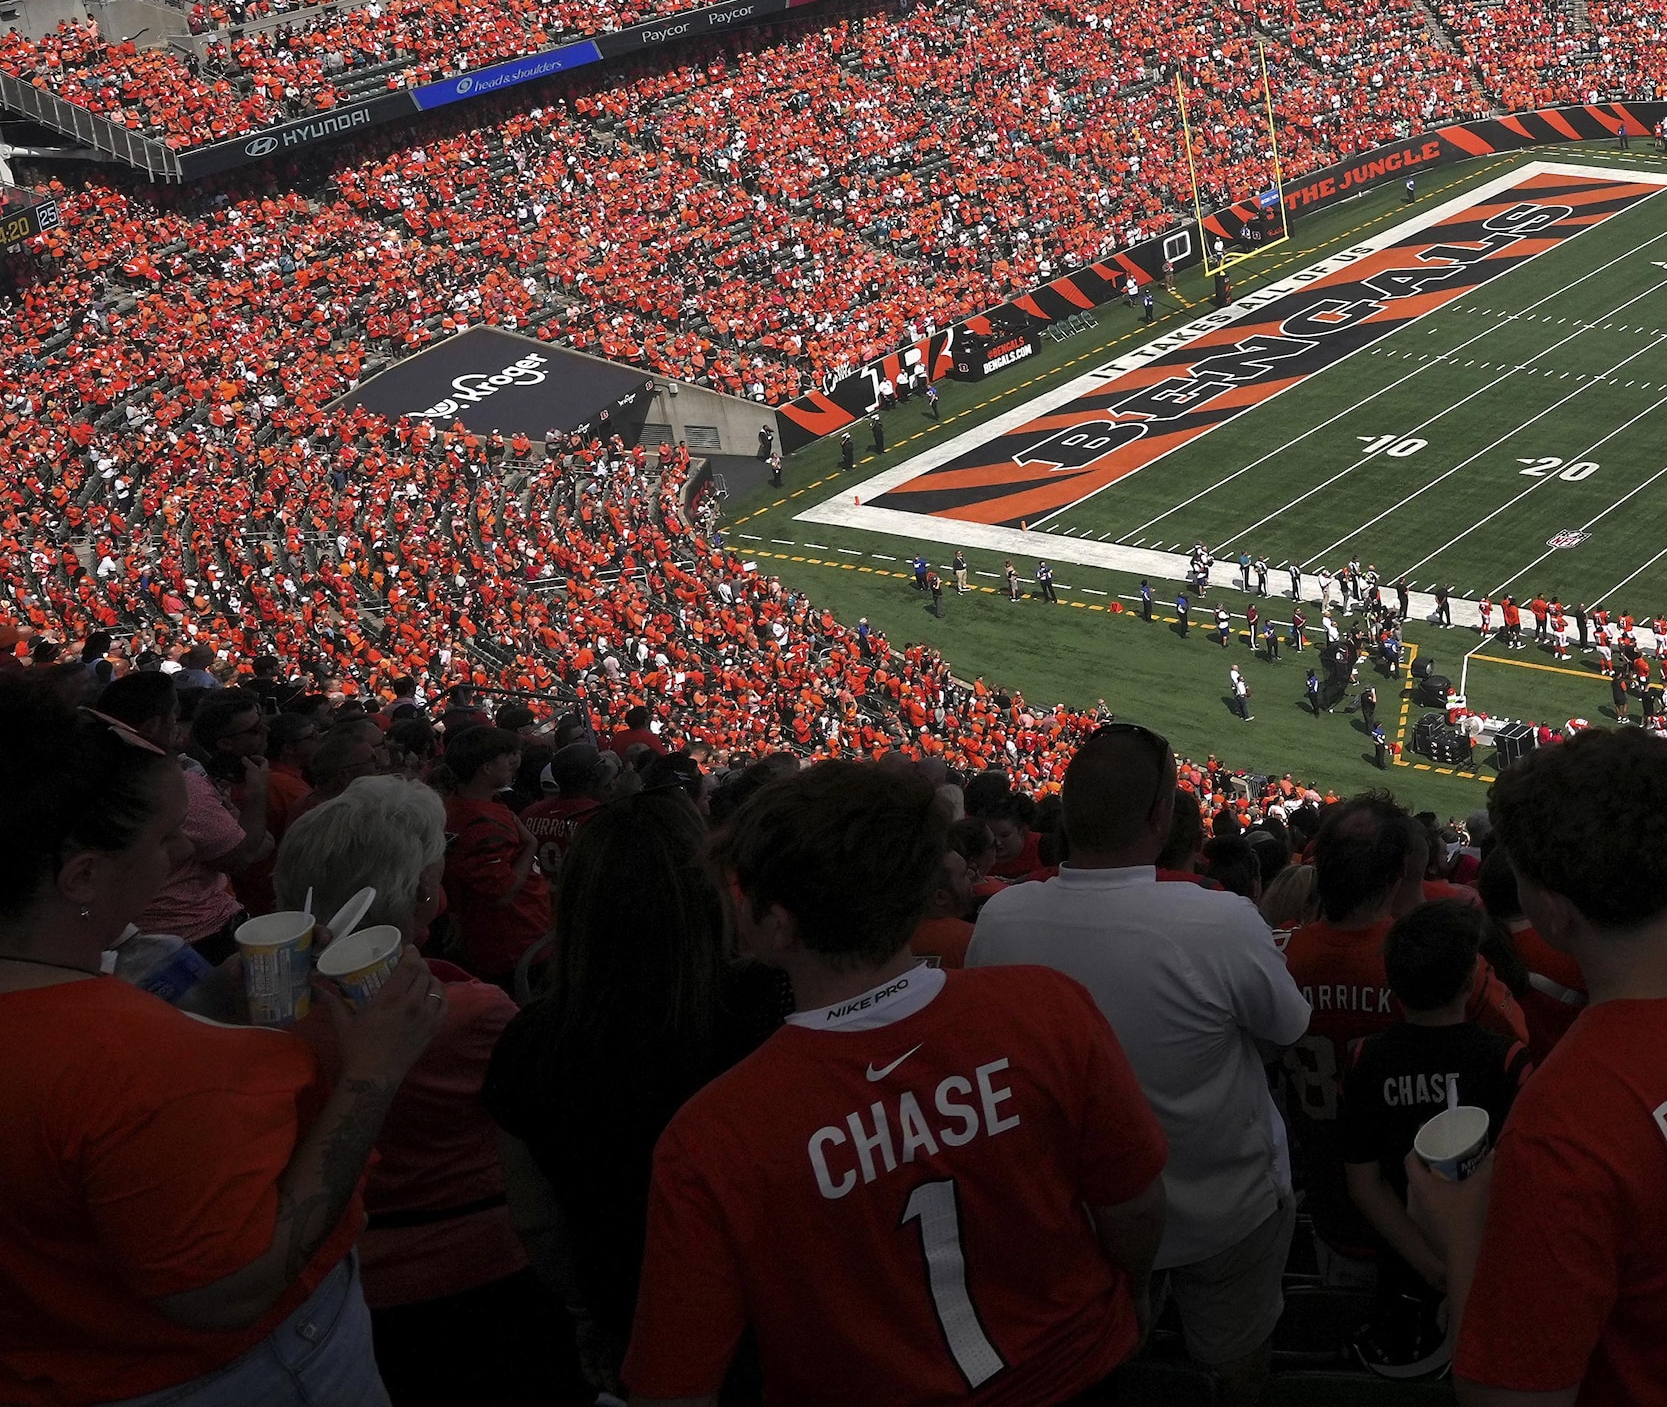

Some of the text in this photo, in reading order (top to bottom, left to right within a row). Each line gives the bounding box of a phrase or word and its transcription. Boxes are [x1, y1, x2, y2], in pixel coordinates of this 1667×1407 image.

[641, 21, 690, 43] Paycor
[708, 4, 754, 25] Paycor
[282, 108, 371, 147] HYUNDAI
[1282, 177, 1336, 211] THE
[1340, 140, 1440, 189] JUNGLE
[40, 206, 57, 227] 25
[1090, 245, 1376, 379] IT TAKES ALL OF US
[987, 336, 1025, 360] @BENGALS
[1012, 202, 1574, 472] BENGALS
[452, 352, 548, 403] Kroger
[983, 344, 1032, 375] BENGALS.COM
[1363, 434, 1428, 458] 10
[1519, 456, 1599, 482] 20
[826, 978, 909, 1021] NIKE PRO
[807, 1057, 1021, 1200] CHASE
[901, 1177, 1006, 1390] 1
